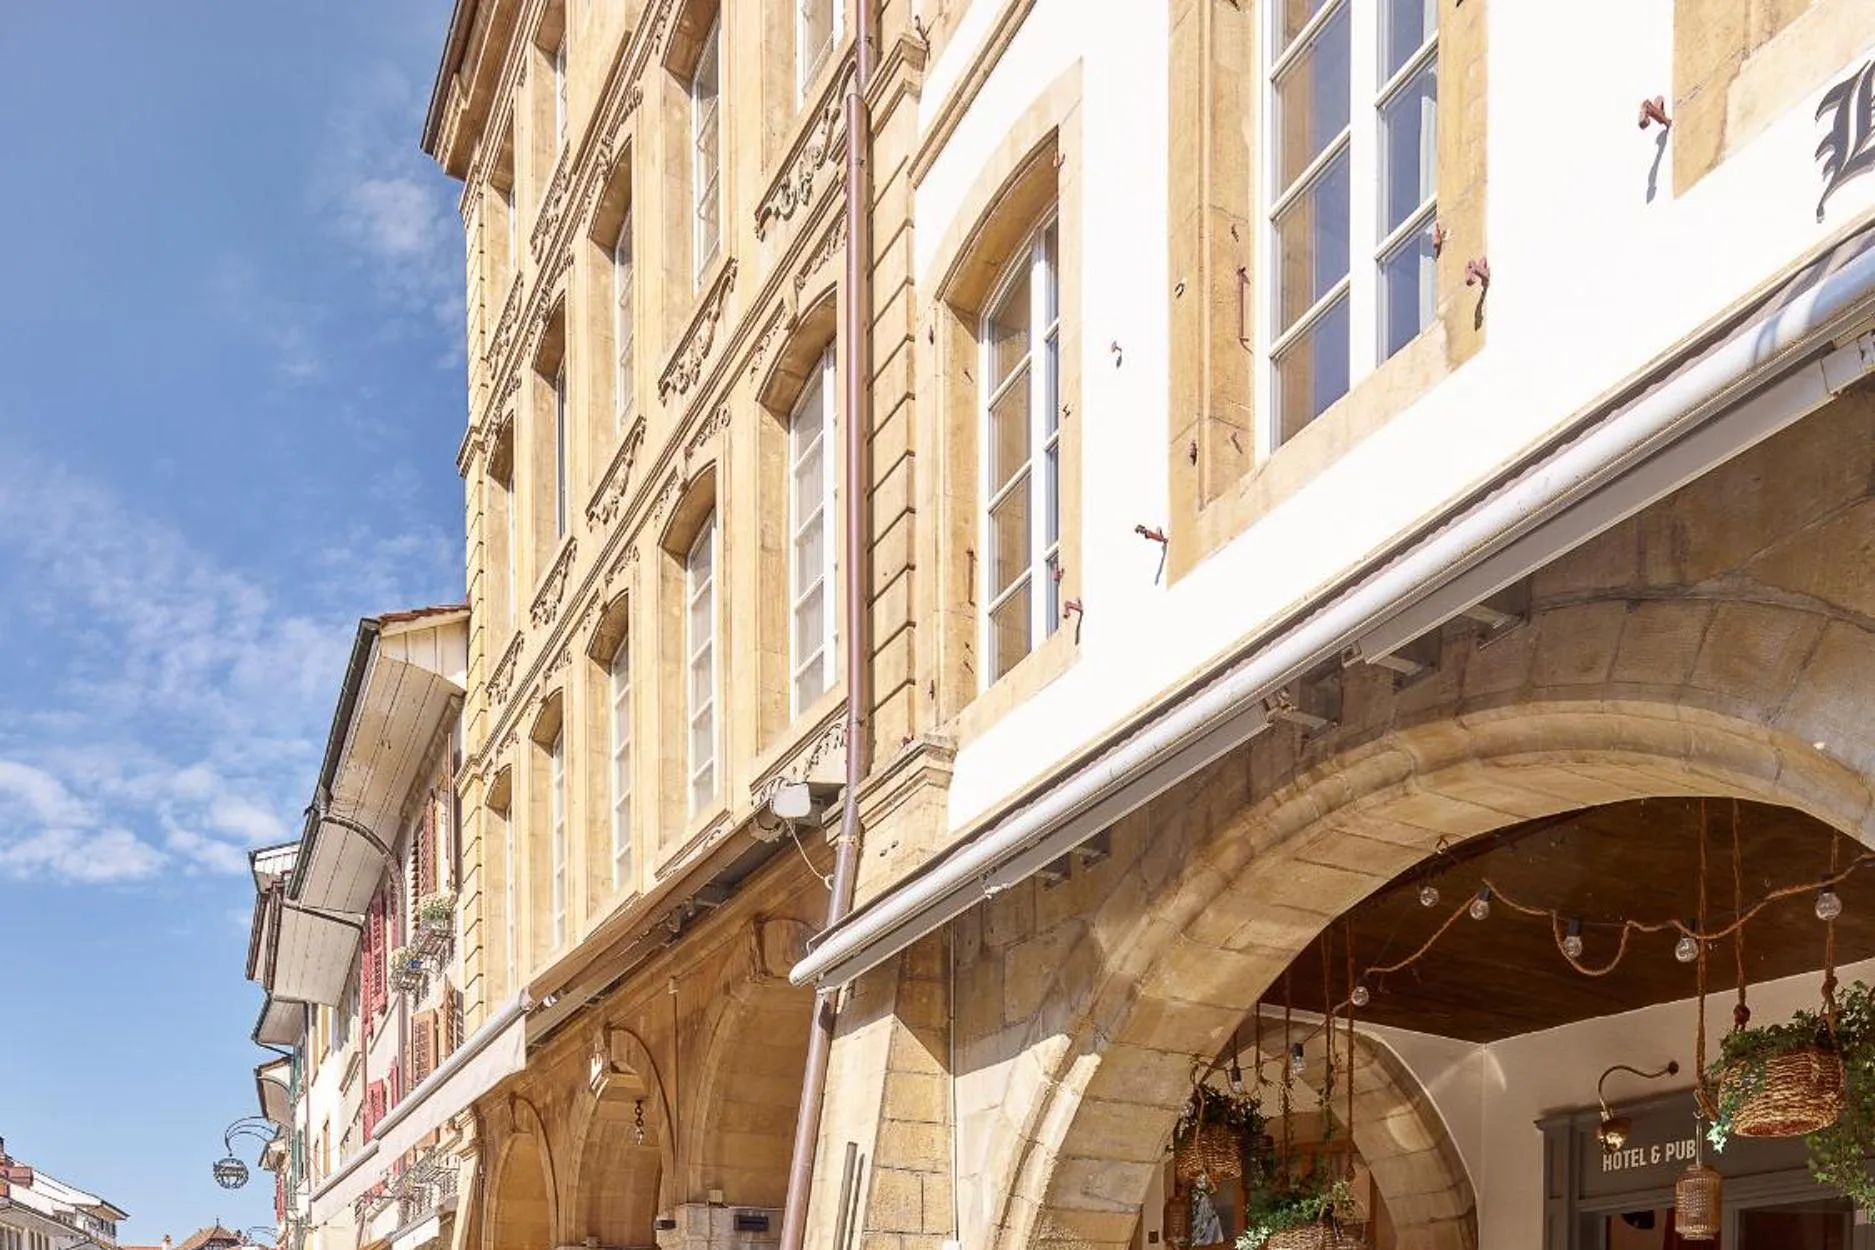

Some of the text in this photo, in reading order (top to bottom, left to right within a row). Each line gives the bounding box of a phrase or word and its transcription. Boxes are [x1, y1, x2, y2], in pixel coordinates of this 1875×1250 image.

[1602, 1139, 1696, 1172] HOTEL & PUB
